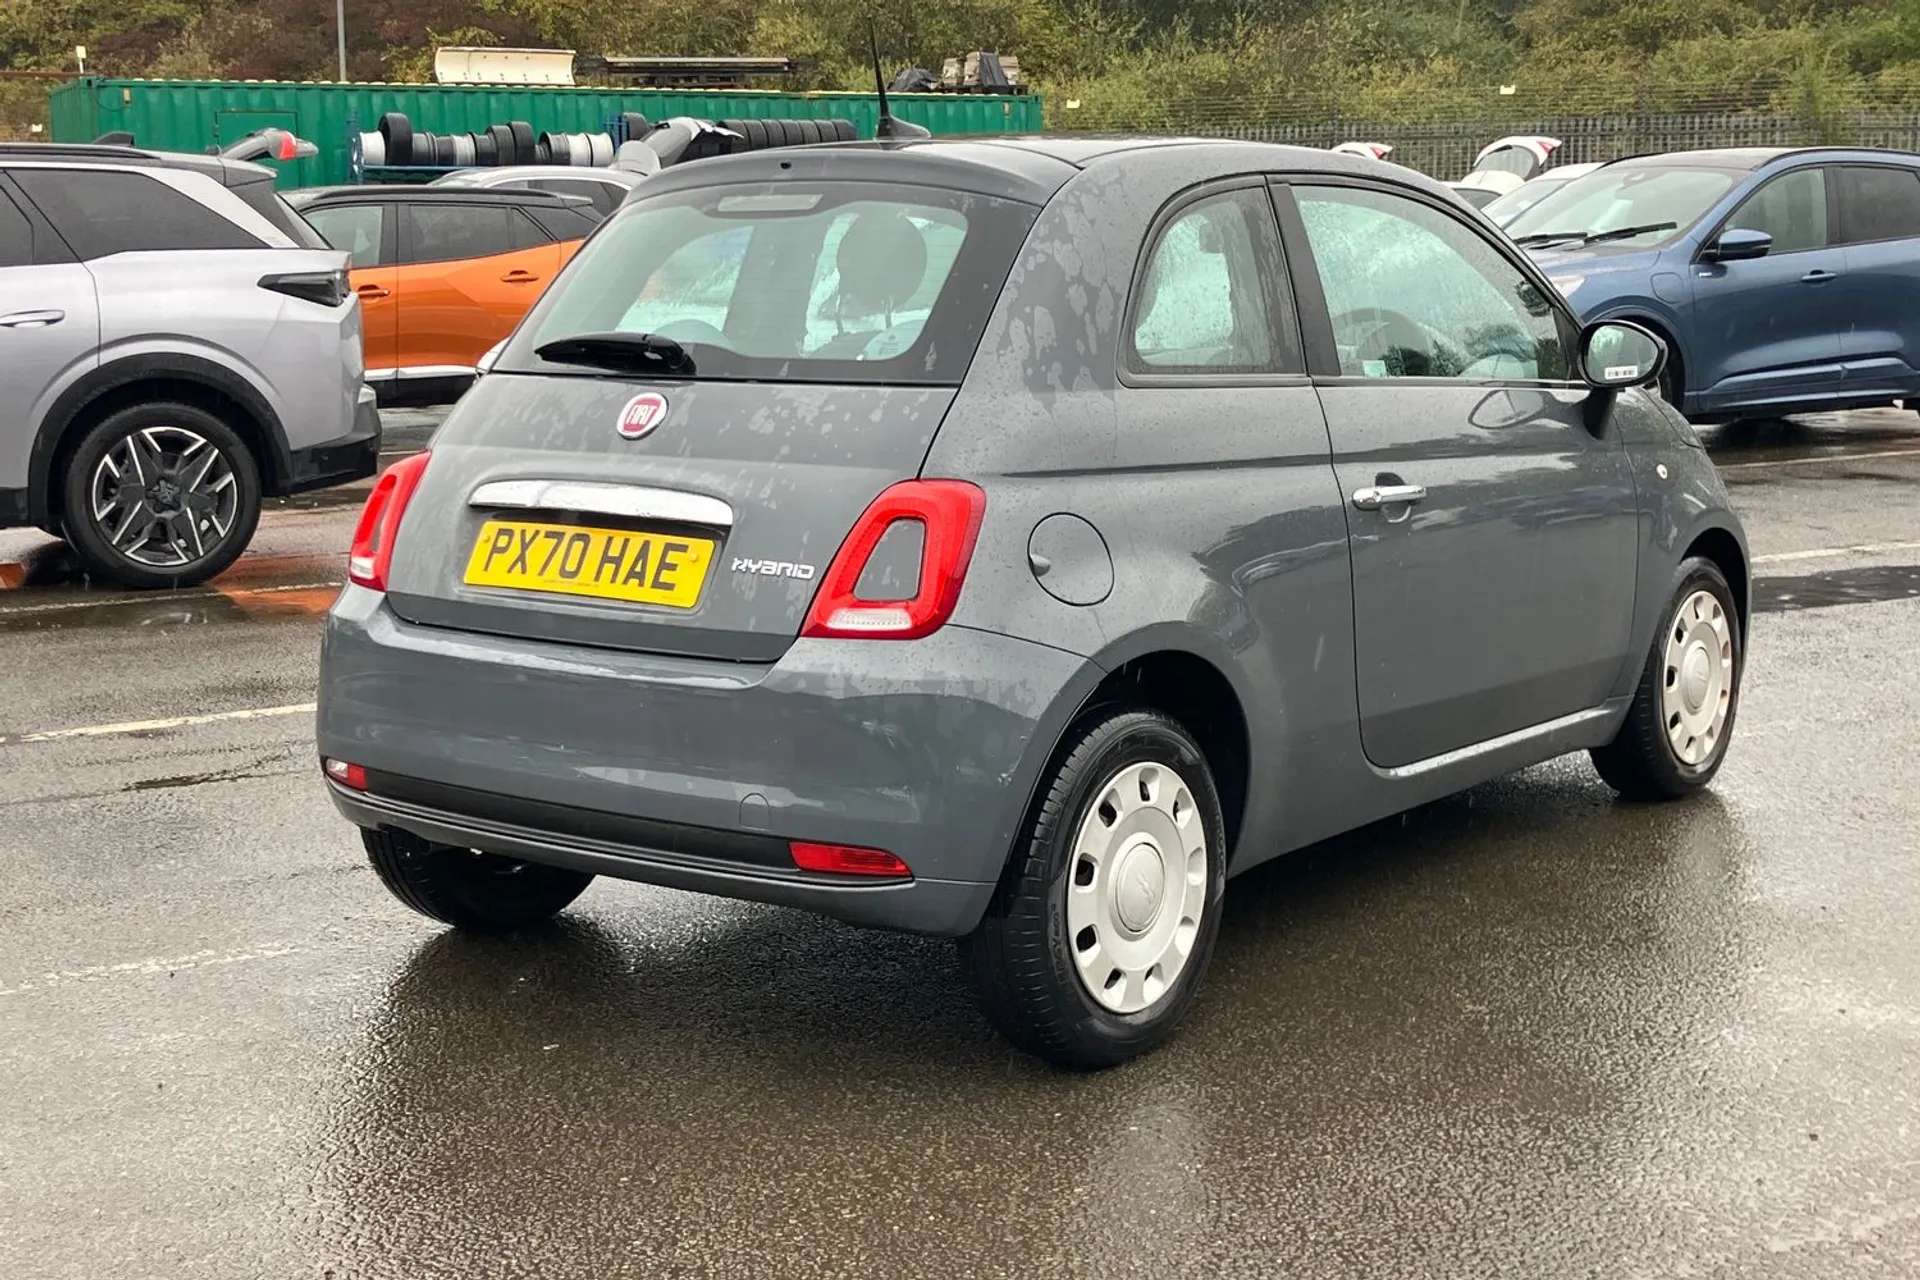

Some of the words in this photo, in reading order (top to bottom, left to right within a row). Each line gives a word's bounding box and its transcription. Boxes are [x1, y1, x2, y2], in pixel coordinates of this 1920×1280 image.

[625, 404, 658, 425] FIAT
[483, 528, 591, 579] PX70
[594, 535, 689, 591] HAE
[731, 558, 815, 580] HYBRID
